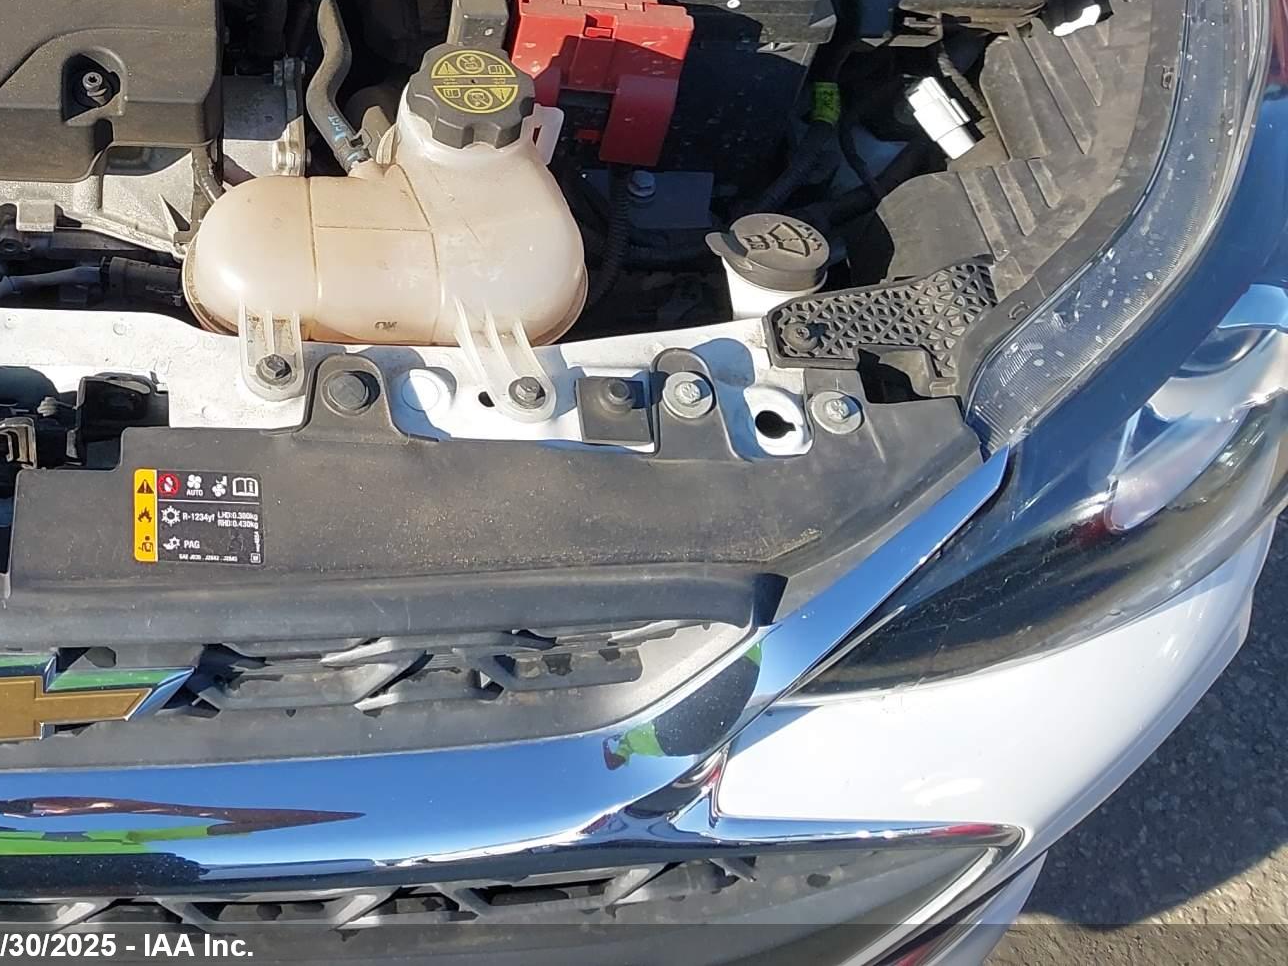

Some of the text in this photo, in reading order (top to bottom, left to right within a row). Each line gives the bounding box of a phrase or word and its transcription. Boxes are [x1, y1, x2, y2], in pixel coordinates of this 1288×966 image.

[186, 489, 204, 497] AUTO
[182, 512, 215, 523] R-1234yf
[183, 539, 201, 549] PAG
